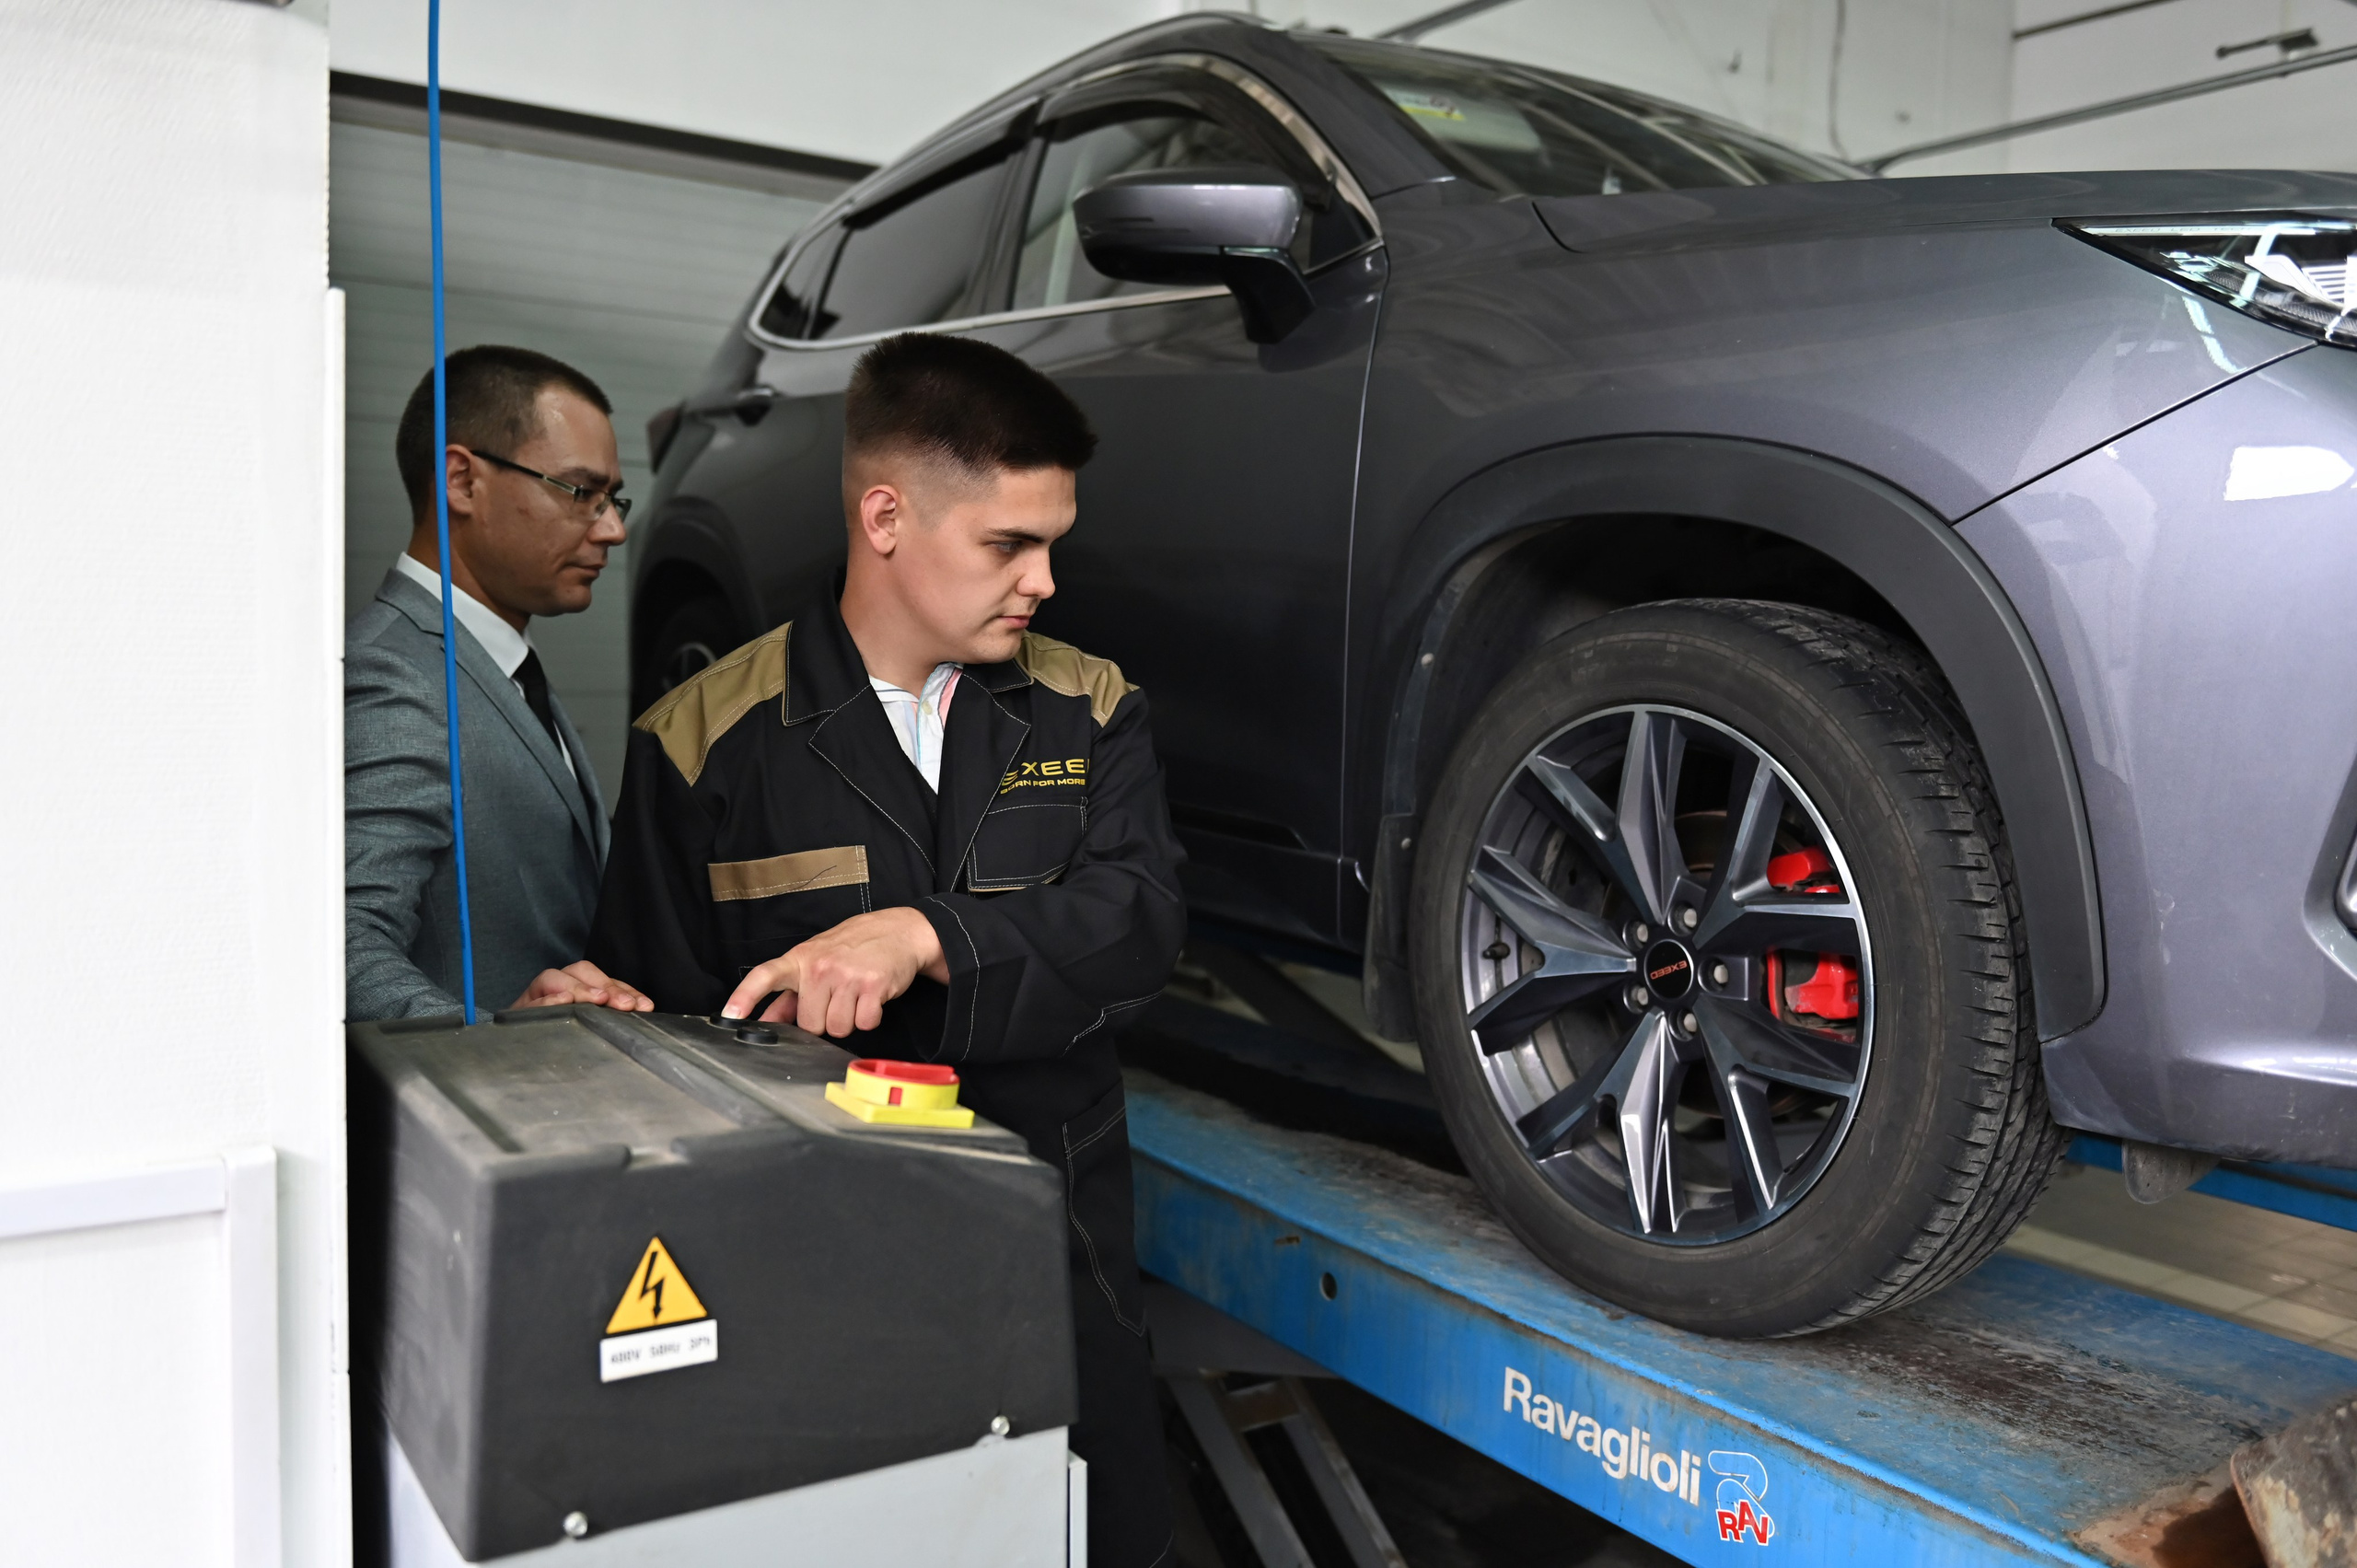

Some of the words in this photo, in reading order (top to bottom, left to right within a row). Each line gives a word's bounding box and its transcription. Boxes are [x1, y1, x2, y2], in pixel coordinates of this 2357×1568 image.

[1001, 758, 1090, 786] EXEE
[1000, 780, 1032, 795] BORN
[1032, 779, 1055, 787] FOR
[1650, 960, 1688, 981] EXEED
[1503, 1366, 1701, 1507] Ravaglioli
[1715, 1499, 1770, 1547] RAV
